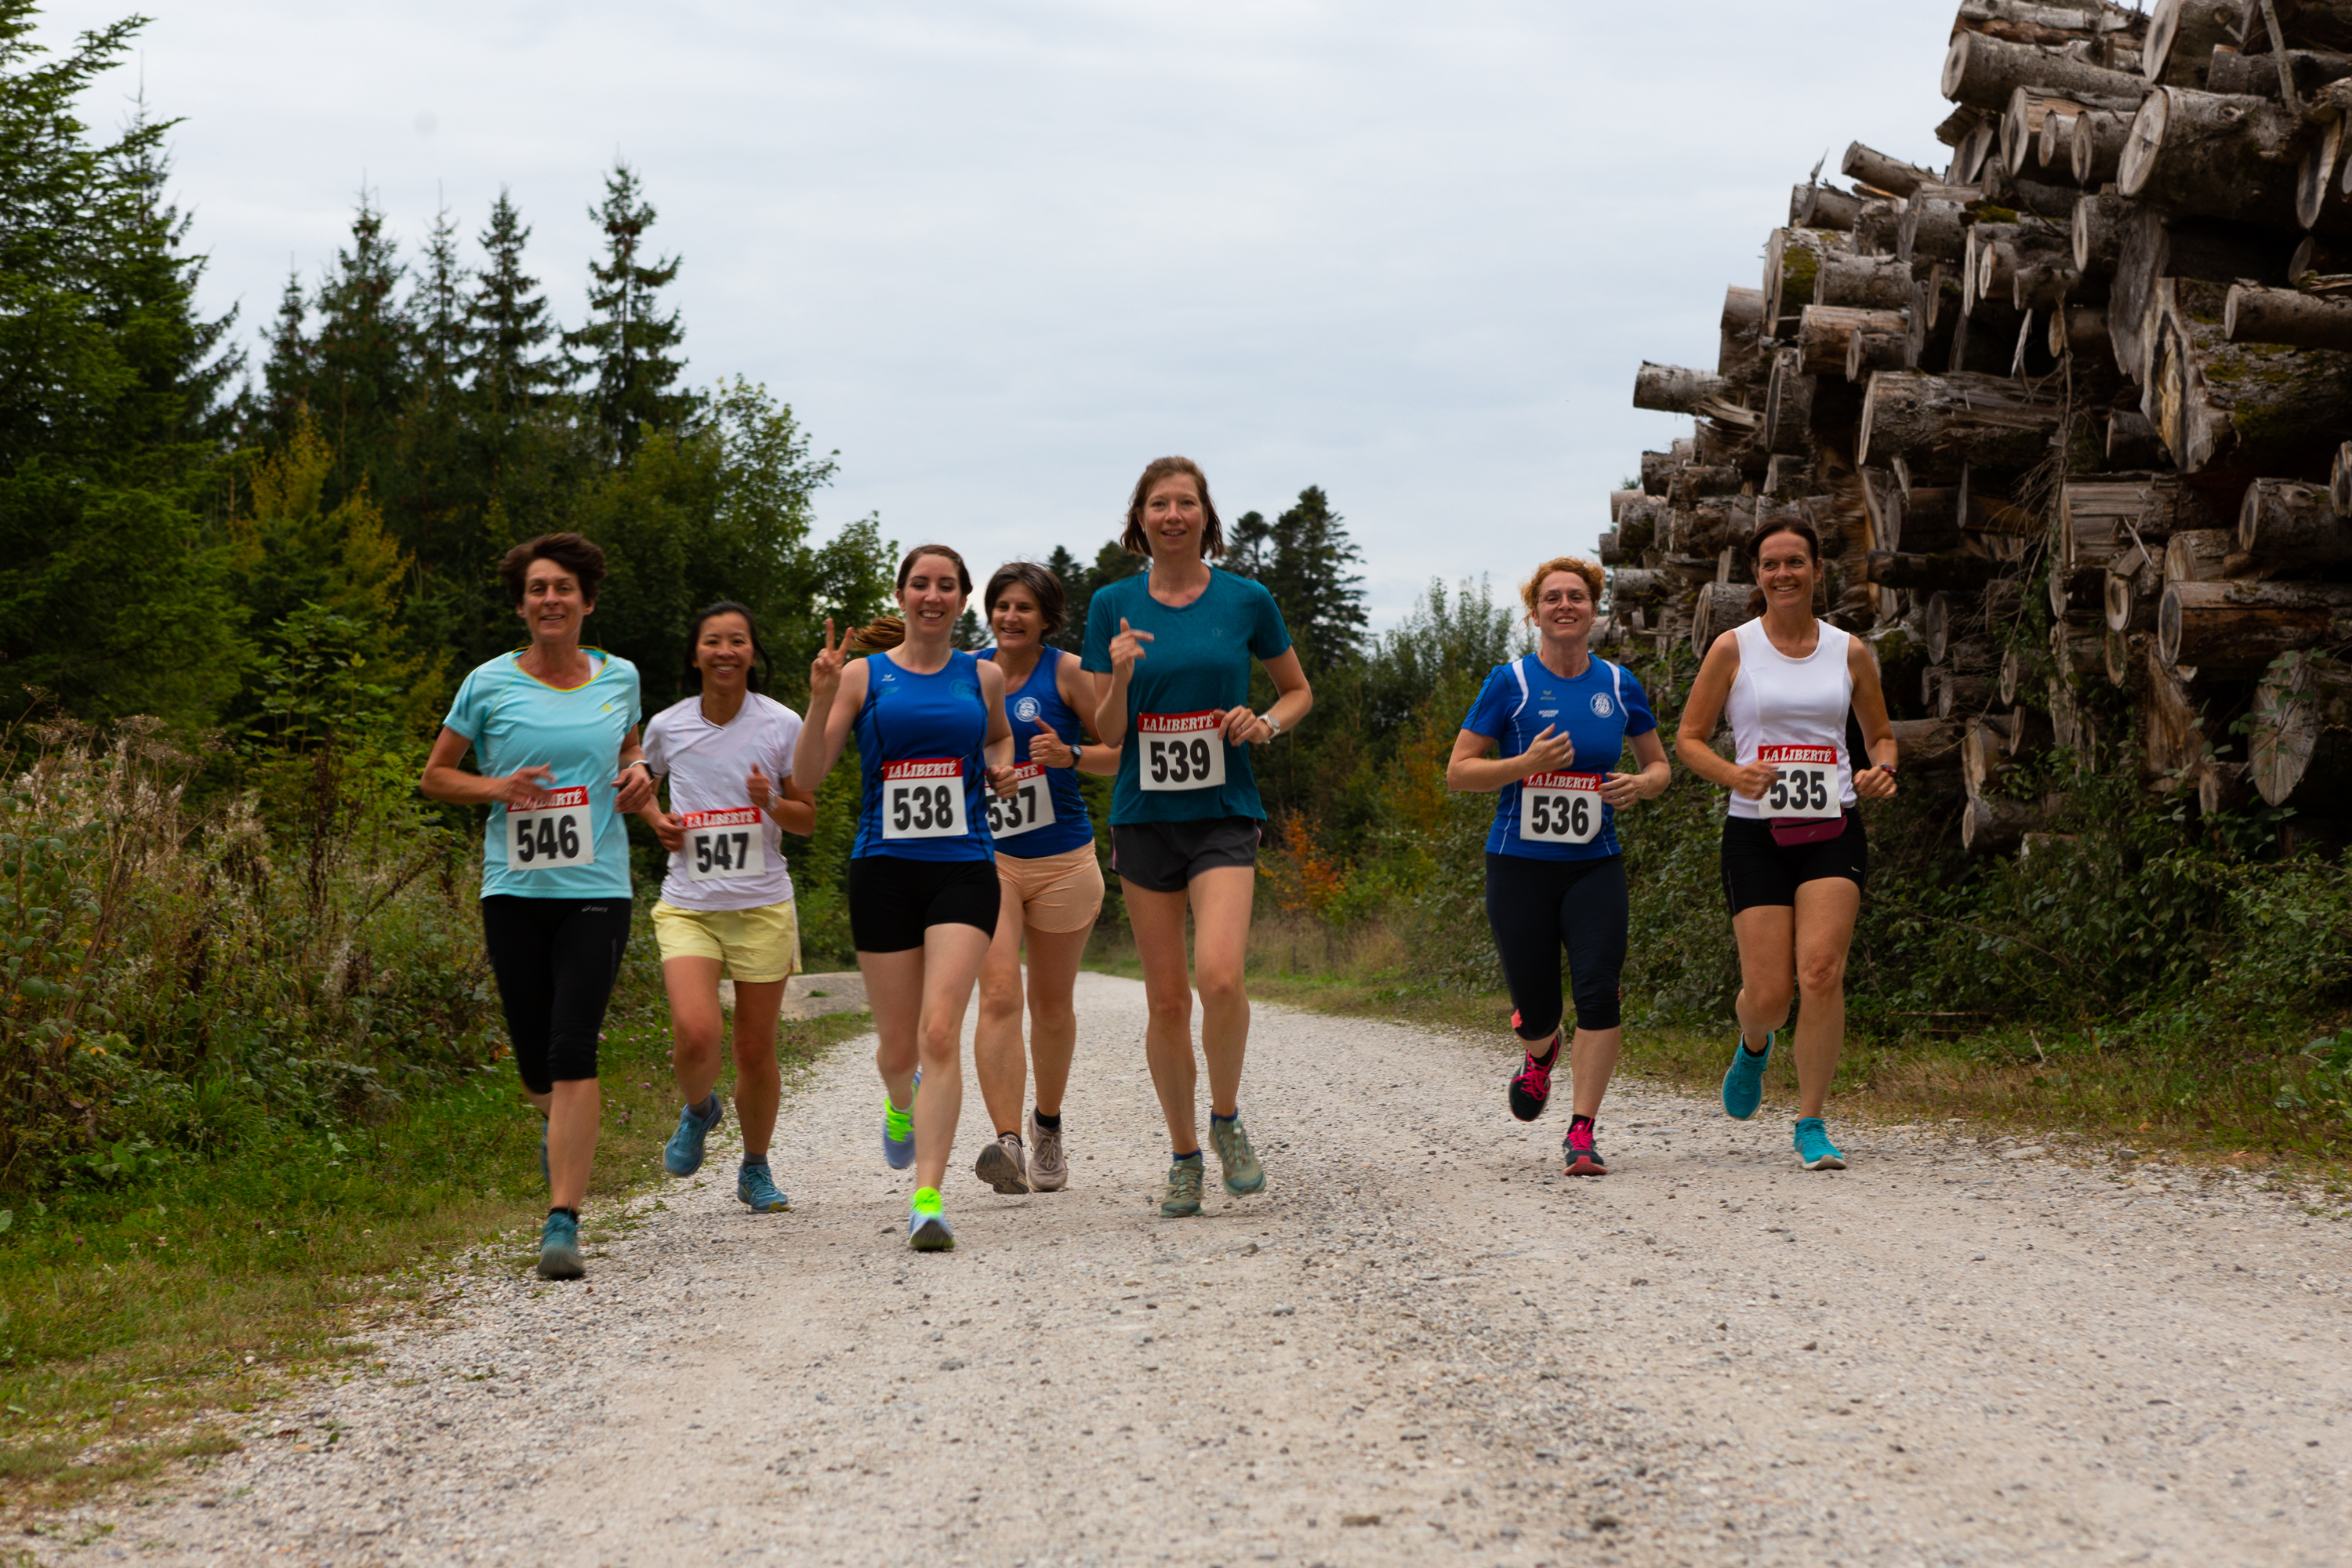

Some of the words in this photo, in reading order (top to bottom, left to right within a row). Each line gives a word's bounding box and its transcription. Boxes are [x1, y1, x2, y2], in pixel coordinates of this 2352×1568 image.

[1142, 717, 1158, 731] LA
[1158, 712, 1214, 732] LIBERTÉ
[887, 764, 902, 779] LA
[902, 760, 957, 778] LIBERTÉ
[1149, 738, 1210, 783] 539
[1762, 749, 1779, 763] LA
[1780, 746, 1832, 763] LIBERTÉ
[1526, 775, 1544, 787] LA
[1543, 773, 1597, 790] LIBERTÉ
[1769, 769, 1828, 811] 535
[685, 815, 702, 828] LA
[702, 808, 756, 827] LIBERTÉ
[893, 785, 953, 831] 538
[985, 785, 1036, 832] 537
[1531, 795, 1589, 837] 536
[517, 814, 579, 863] 546
[695, 832, 749, 873] 547
